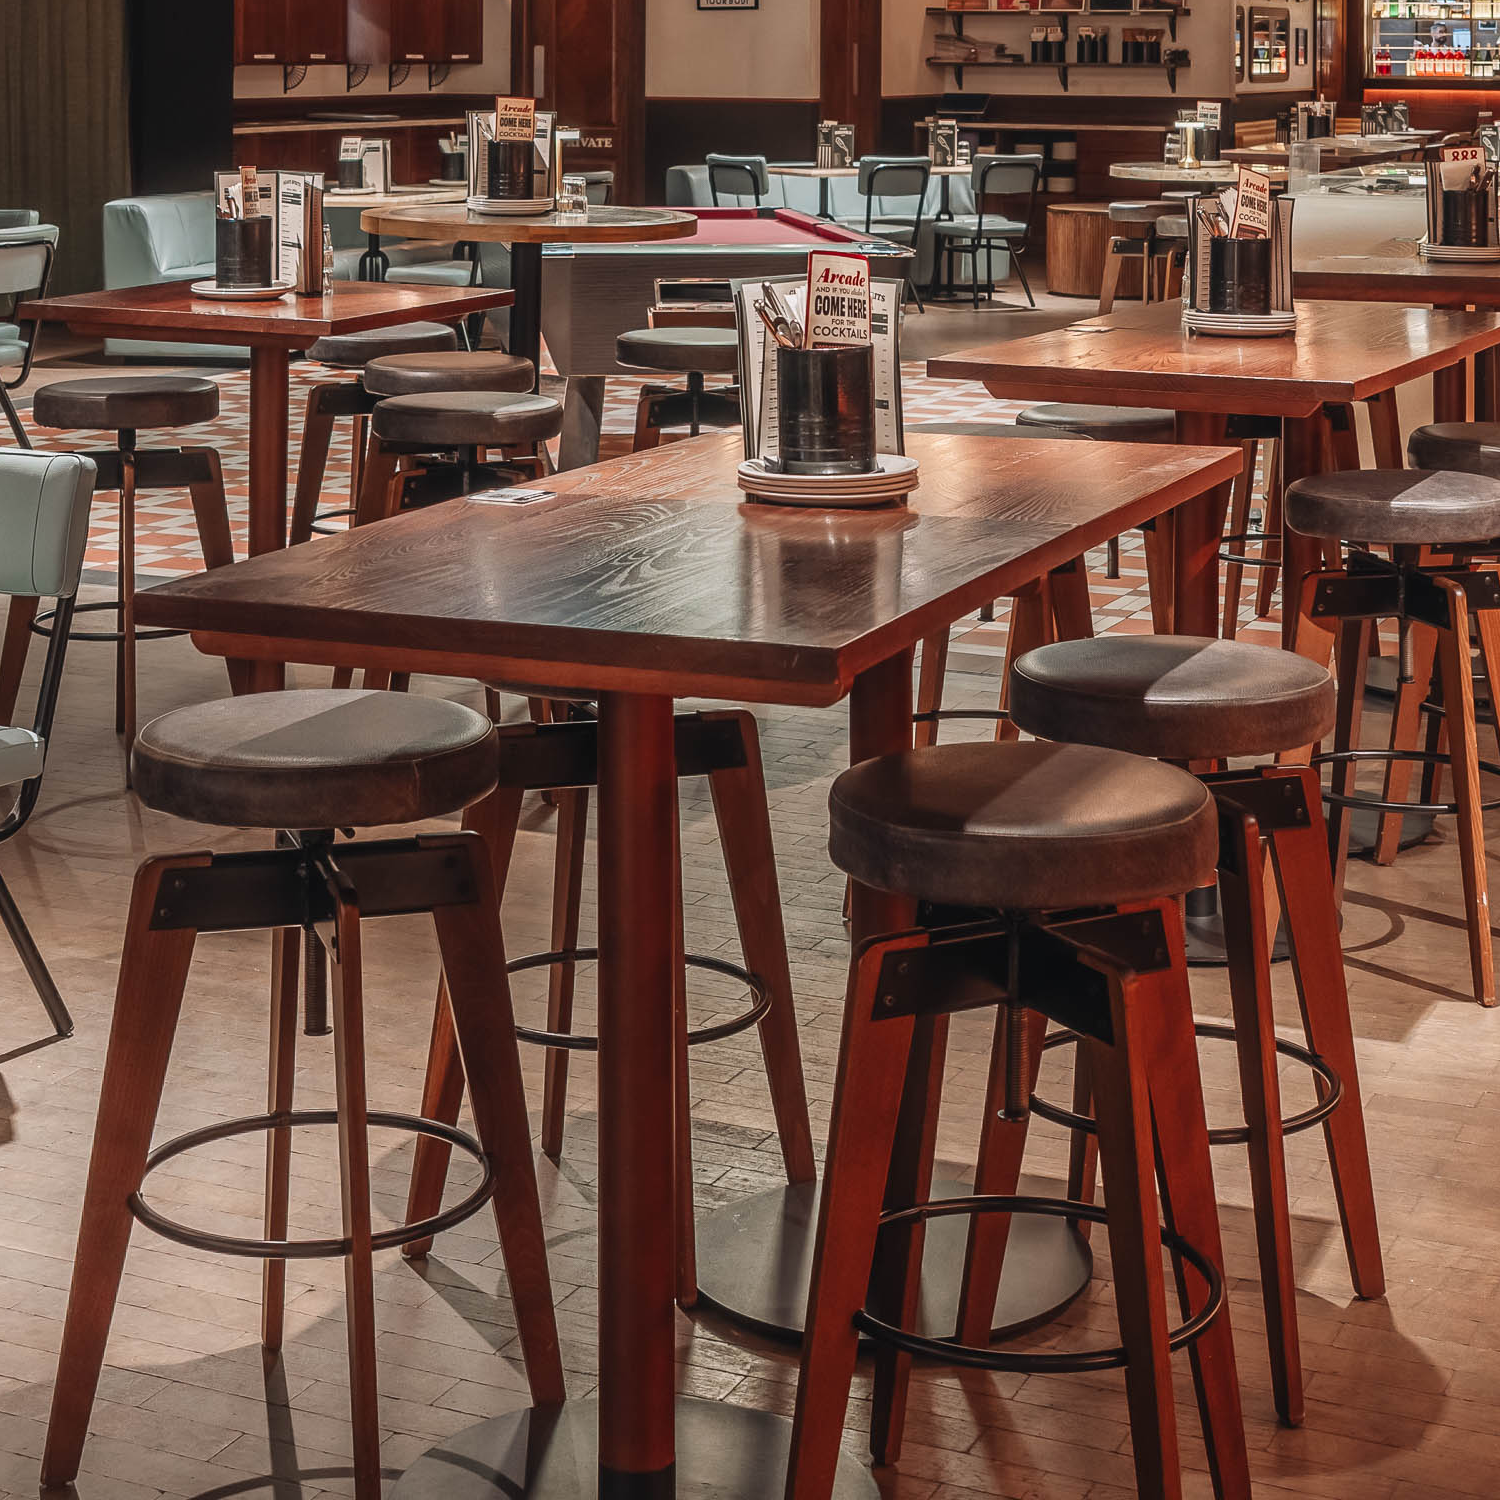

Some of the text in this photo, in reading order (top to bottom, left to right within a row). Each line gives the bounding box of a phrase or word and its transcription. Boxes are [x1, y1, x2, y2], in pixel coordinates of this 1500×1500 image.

[501, 104, 531, 113] Arcade
[500, 117, 531, 128] COME HERE
[564, 138, 613, 148] RIVATE
[1243, 178, 1267, 194] Arcade
[1241, 194, 1257, 210] COME
[1239, 214, 1267, 226] COCKTAILS
[816, 268, 865, 288] Arcade
[815, 294, 867, 320] COME HERE
[813, 326, 867, 340] COCKTAILS
